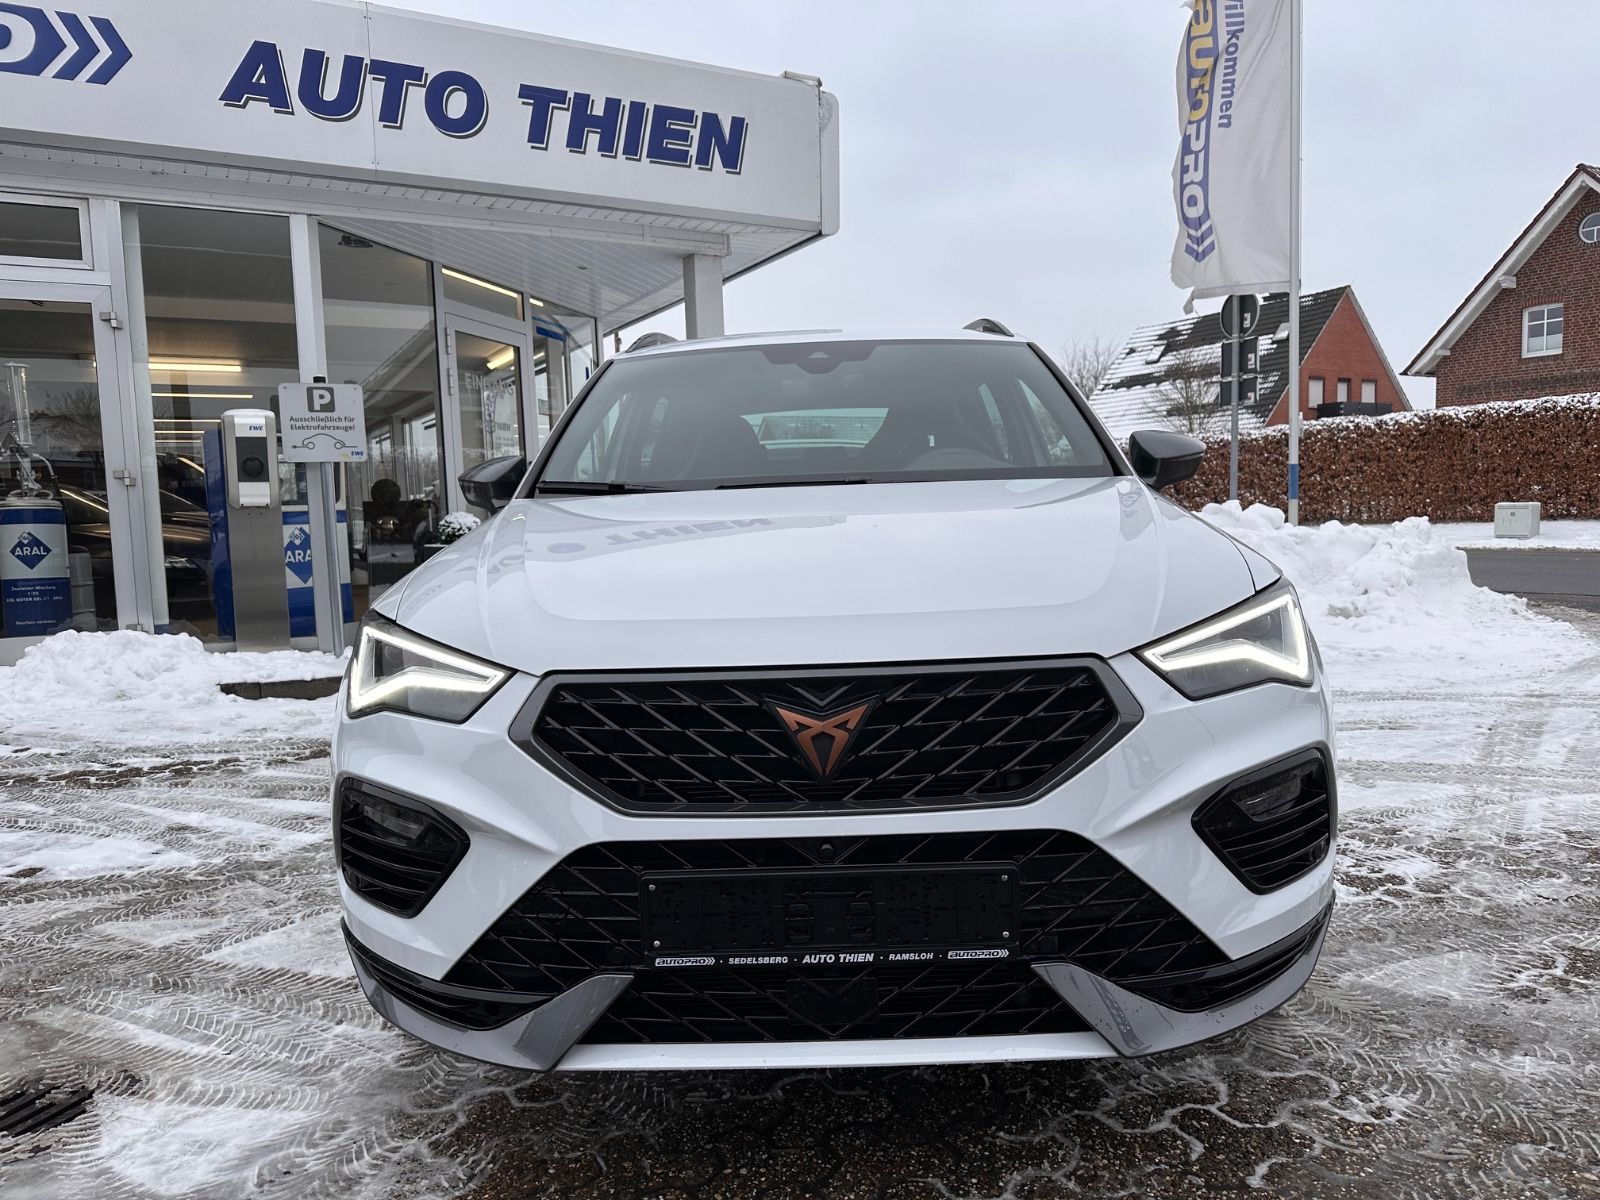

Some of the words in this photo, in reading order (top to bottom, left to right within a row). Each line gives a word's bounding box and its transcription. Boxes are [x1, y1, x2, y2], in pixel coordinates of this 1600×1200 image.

[218, 40, 489, 139] AUTO
[518, 83, 747, 174] THIEN
[313, 389, 332, 411] P
[289, 415, 343, 424] Ausschließlich
[344, 415, 356, 423] für
[290, 424, 356, 432] Elektrofahrzeuge!
[14, 546, 47, 556] ARAL
[728, 956, 789, 965] SEDELSBERG
[802, 954, 835, 964] AUTO
[838, 953, 875, 963] THIEN
[888, 952, 934, 961] RAMSLOH
